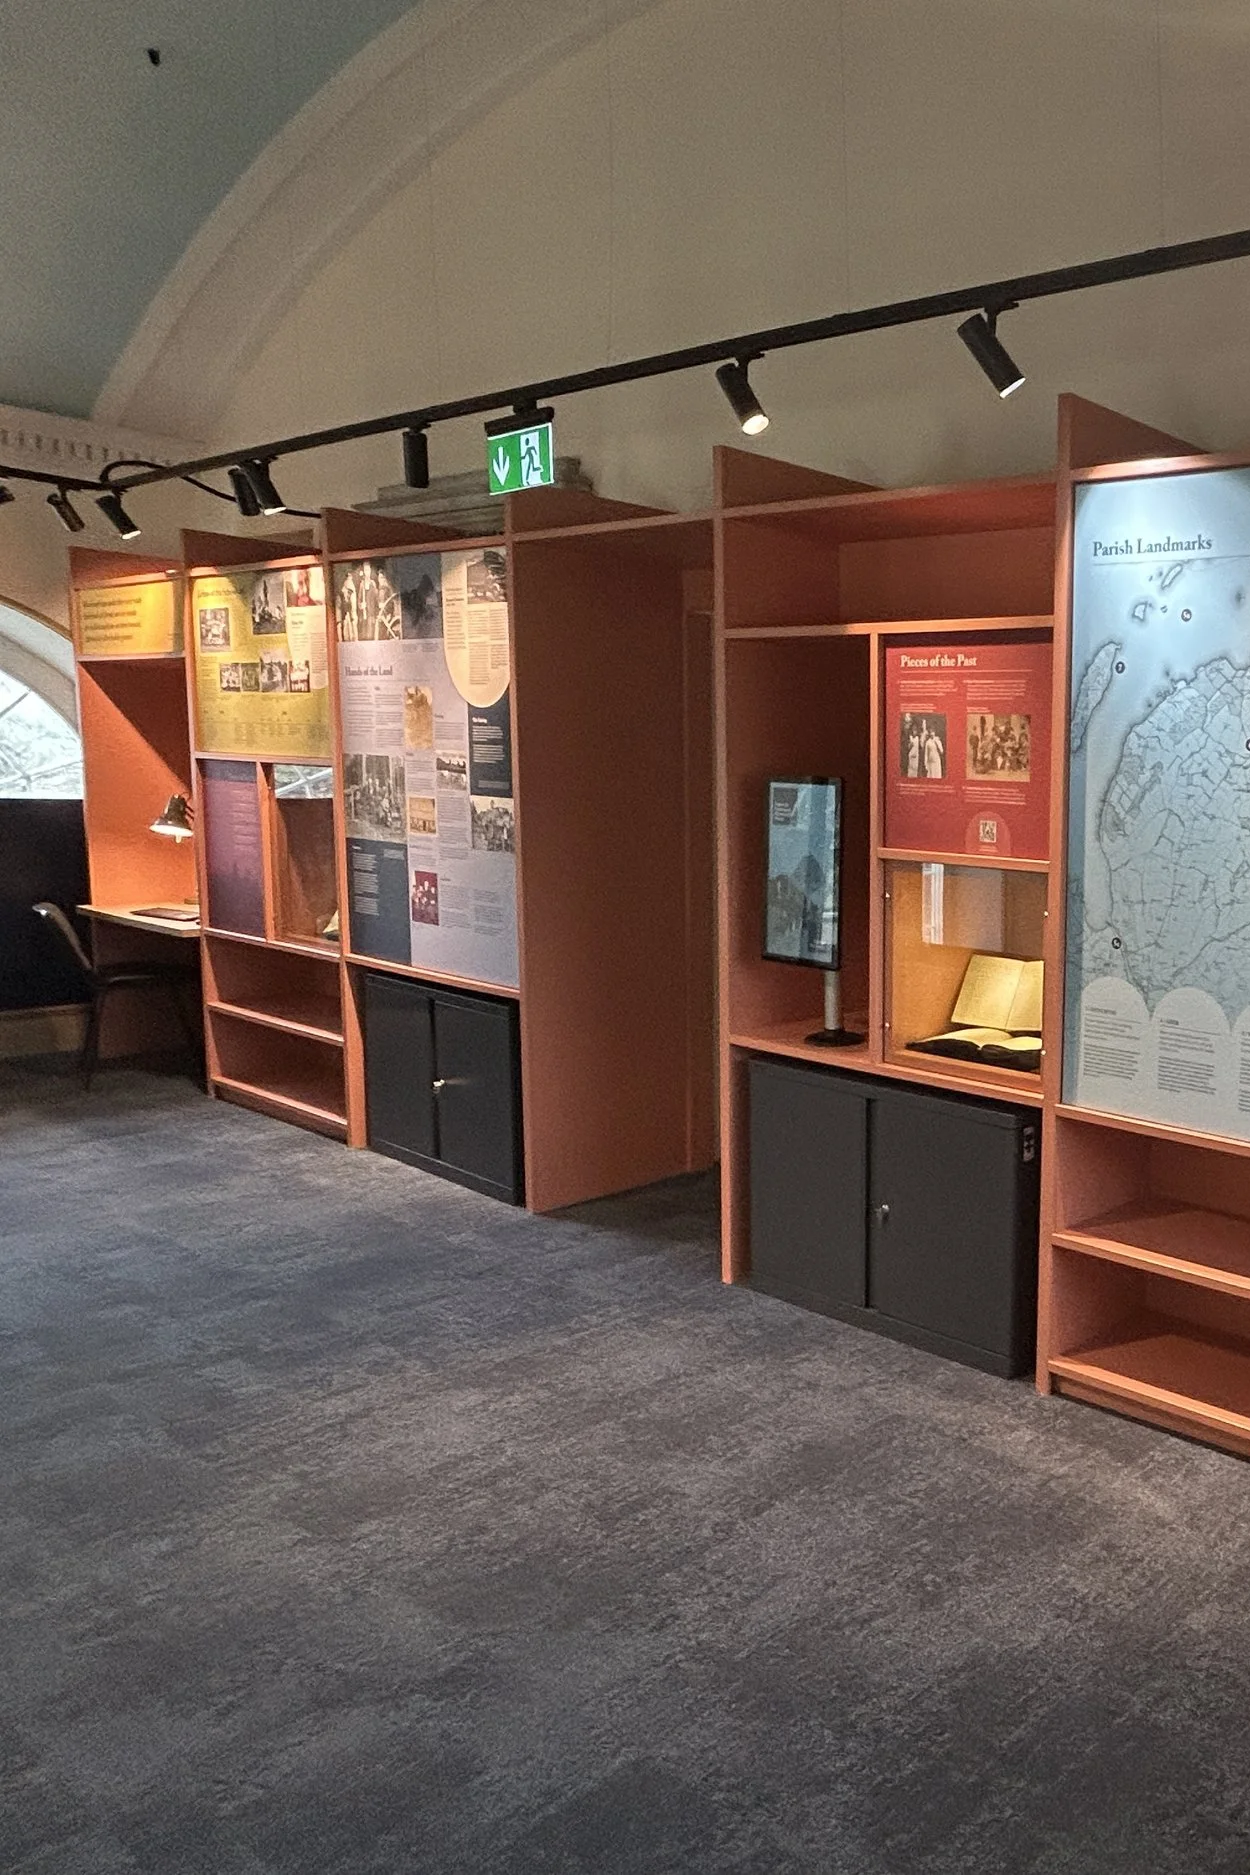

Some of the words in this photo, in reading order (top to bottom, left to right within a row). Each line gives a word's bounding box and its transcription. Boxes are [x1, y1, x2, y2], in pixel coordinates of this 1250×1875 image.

[1093, 539, 1132, 557] Parish
[1136, 534, 1212, 554] Landmarks
[901, 654, 928, 667] Pieces
[929, 654, 941, 667] of
[941, 654, 956, 667] the
[957, 653, 977, 667] Past
